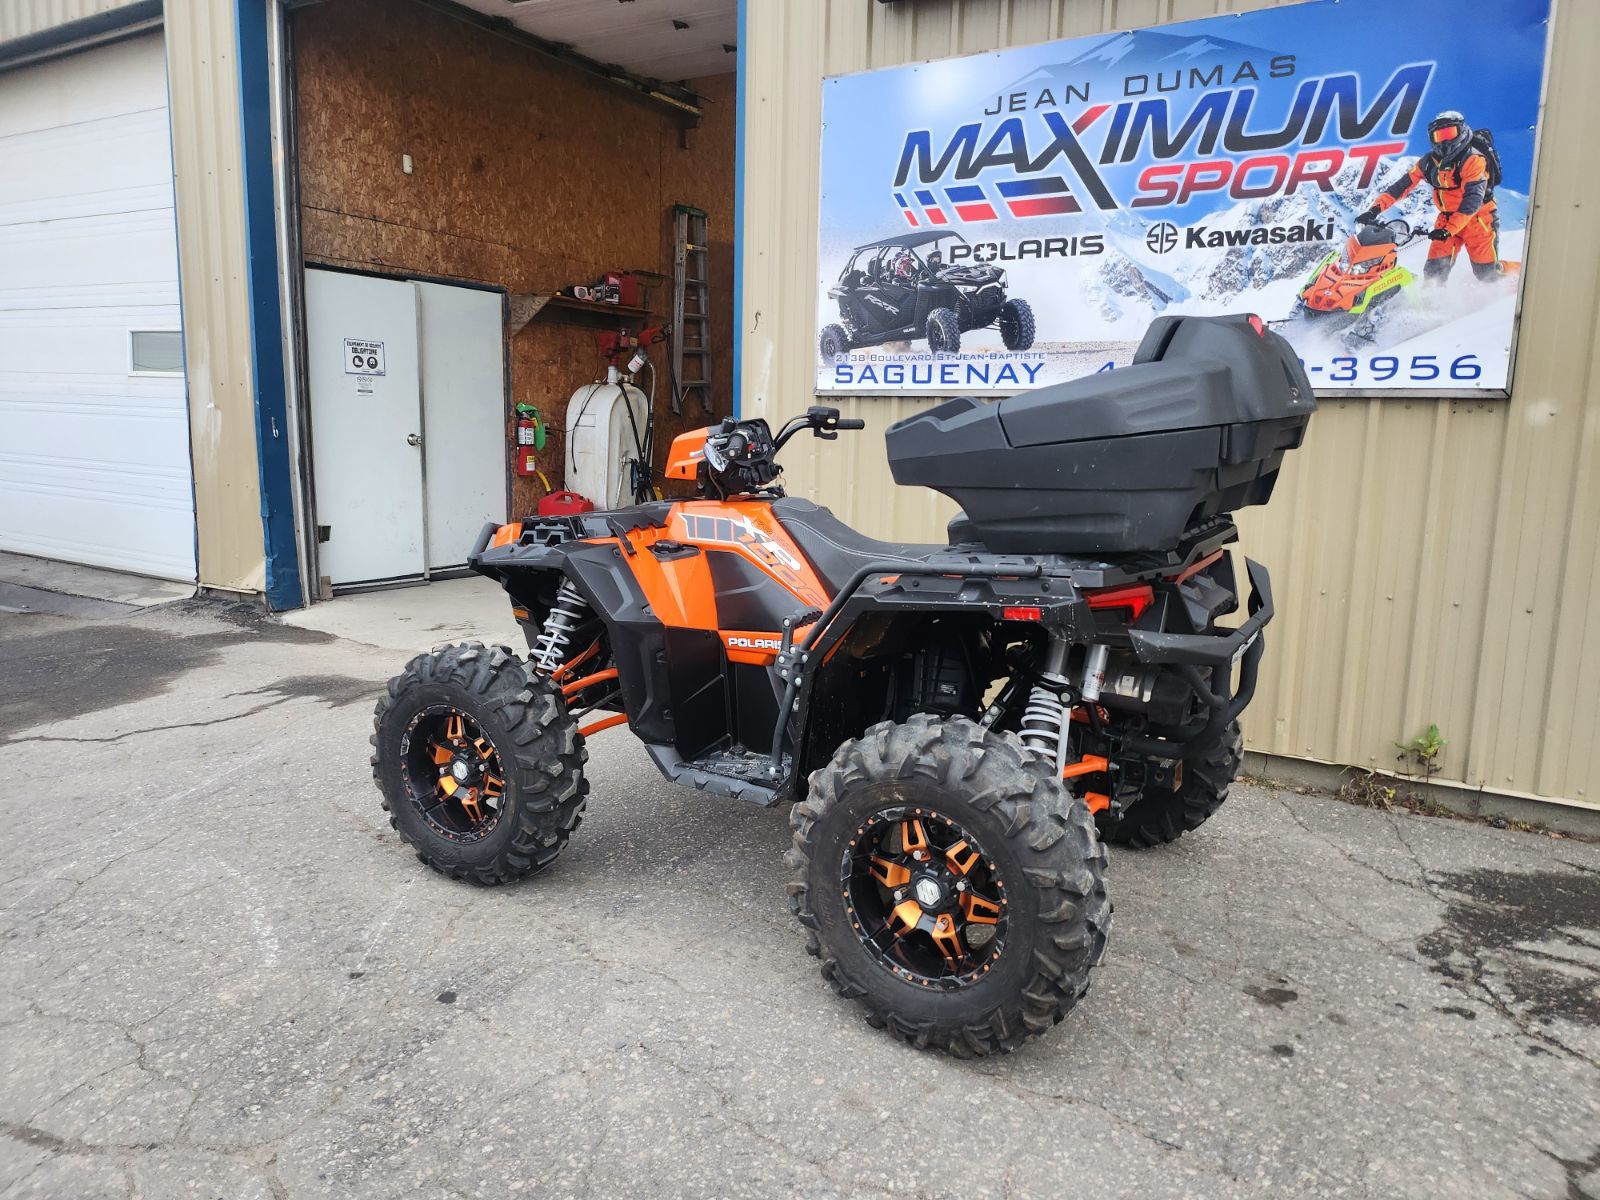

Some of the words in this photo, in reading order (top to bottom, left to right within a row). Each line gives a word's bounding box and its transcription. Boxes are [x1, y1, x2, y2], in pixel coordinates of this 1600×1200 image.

[984, 82, 1091, 116] JEAN
[1124, 54, 1297, 97] DUMAS
[894, 62, 1436, 208] MAXIMUM
[1131, 142, 1406, 207] SPORT
[1186, 217, 1334, 249] Kawasaki
[950, 235, 1104, 263] POLARIS
[836, 354, 865, 362] 2138
[1299, 355, 1482, 381] -3956
[835, 363, 1045, 384] SAGUENAY
